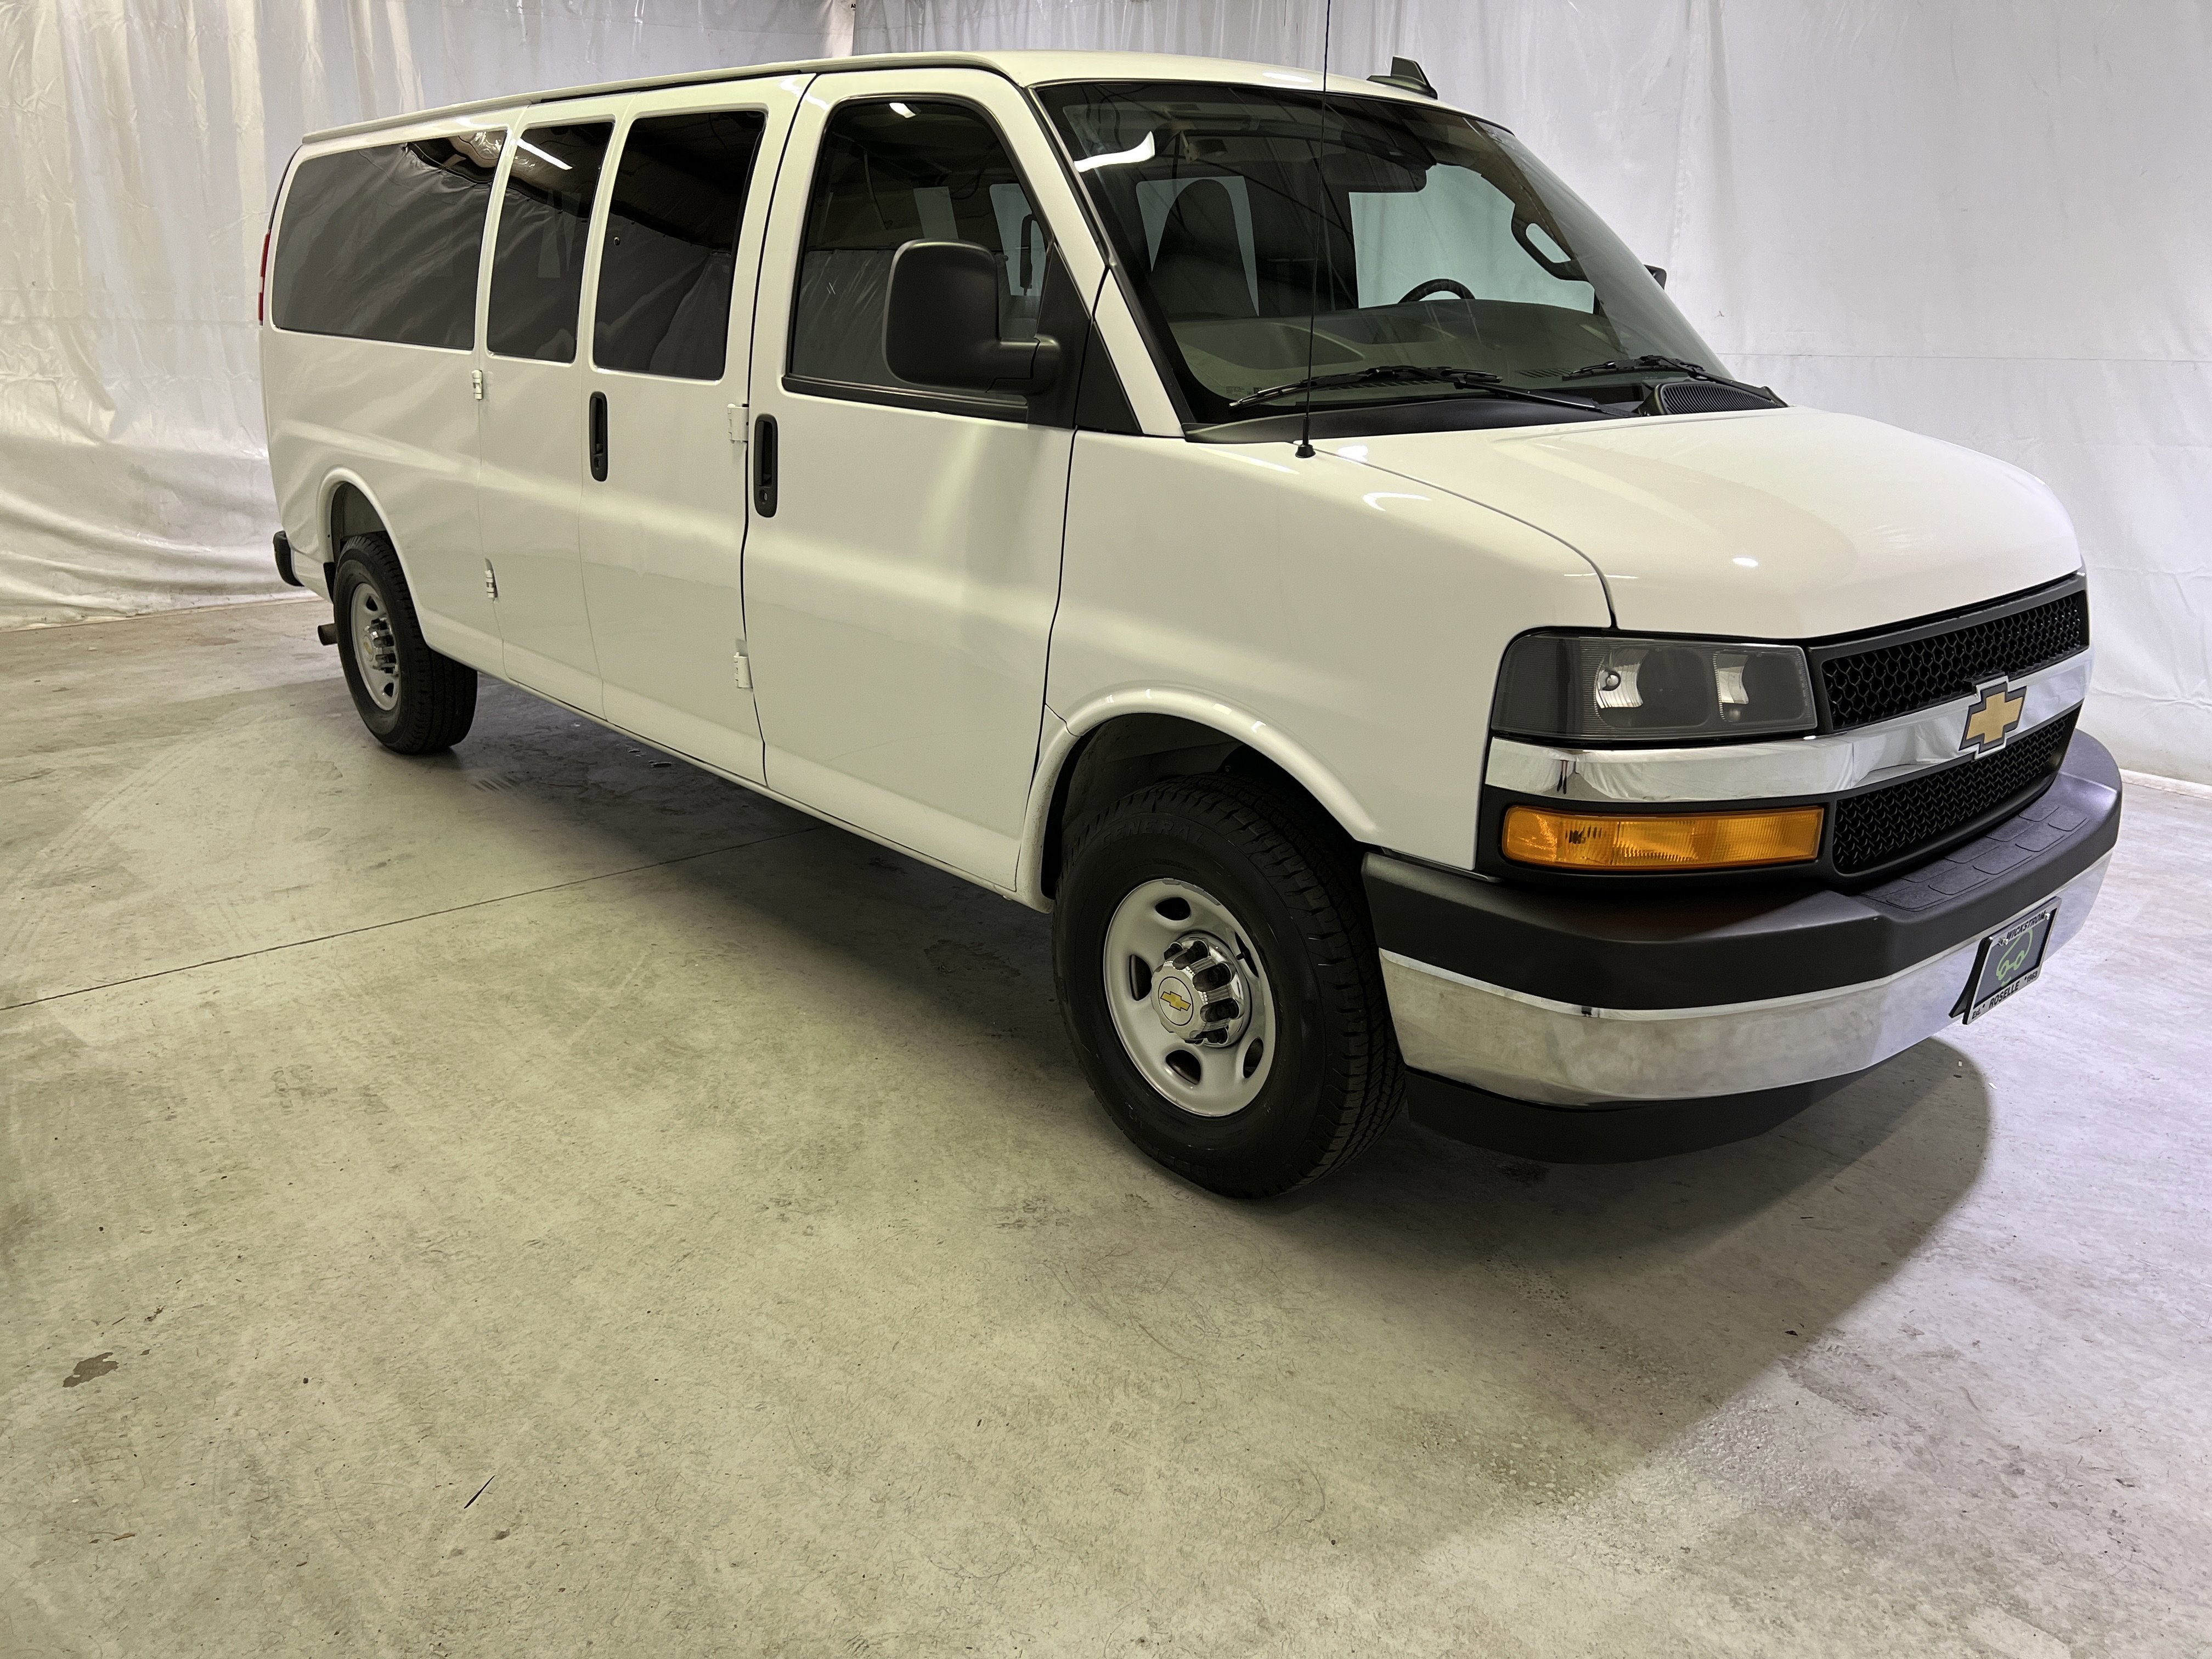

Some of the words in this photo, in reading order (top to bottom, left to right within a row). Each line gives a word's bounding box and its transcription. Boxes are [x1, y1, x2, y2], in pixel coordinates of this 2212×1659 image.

[1103, 820, 1205, 851] GENERAL
[2006, 910, 2046, 940] WICKSTROM
[1989, 980, 2020, 1008] ROSELLE
